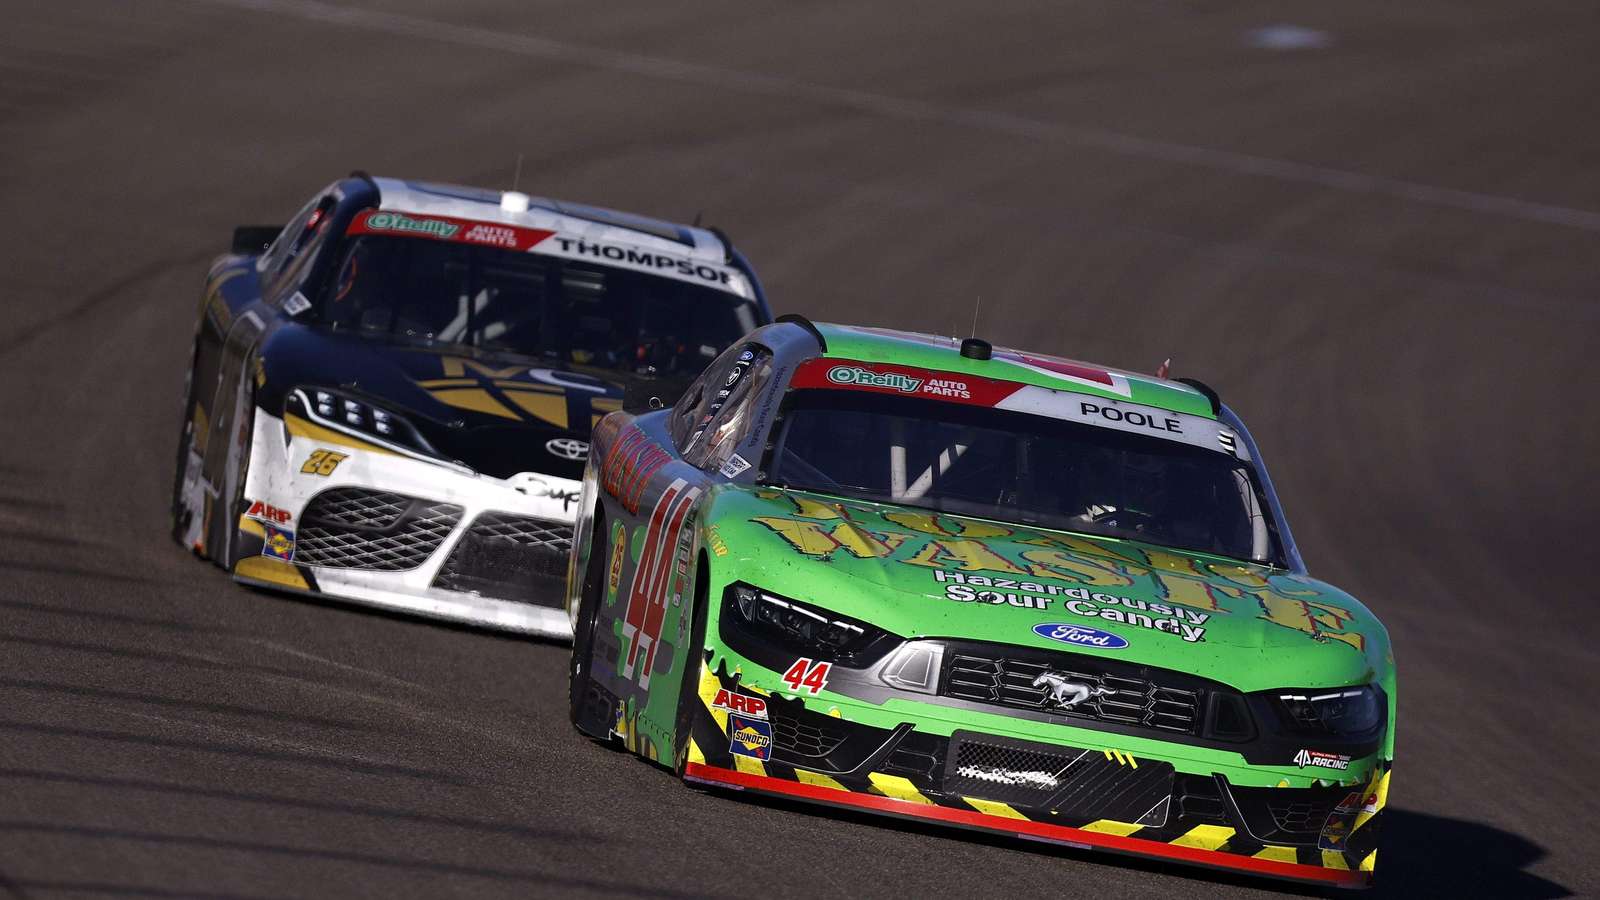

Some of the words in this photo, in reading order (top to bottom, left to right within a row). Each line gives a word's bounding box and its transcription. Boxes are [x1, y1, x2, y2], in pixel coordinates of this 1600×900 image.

[464, 232, 517, 248] PARTS
[473, 224, 515, 237] AUTO
[827, 365, 924, 393] O'Reilly
[929, 379, 967, 391] AUTO
[923, 385, 971, 399] PARTS
[1080, 402, 1183, 434] POOLE
[301, 448, 349, 476] 26
[249, 501, 291, 524] ARP
[934, 569, 1210, 625] Hazardously
[945, 584, 1054, 611] Sour
[1064, 599, 1207, 643] Candy
[1051, 624, 1110, 647] Ford
[781, 657, 832, 695] 44
[712, 688, 766, 715] ARP
[734, 730, 769, 748] SUNOCO
[1311, 757, 1348, 770] RACING
